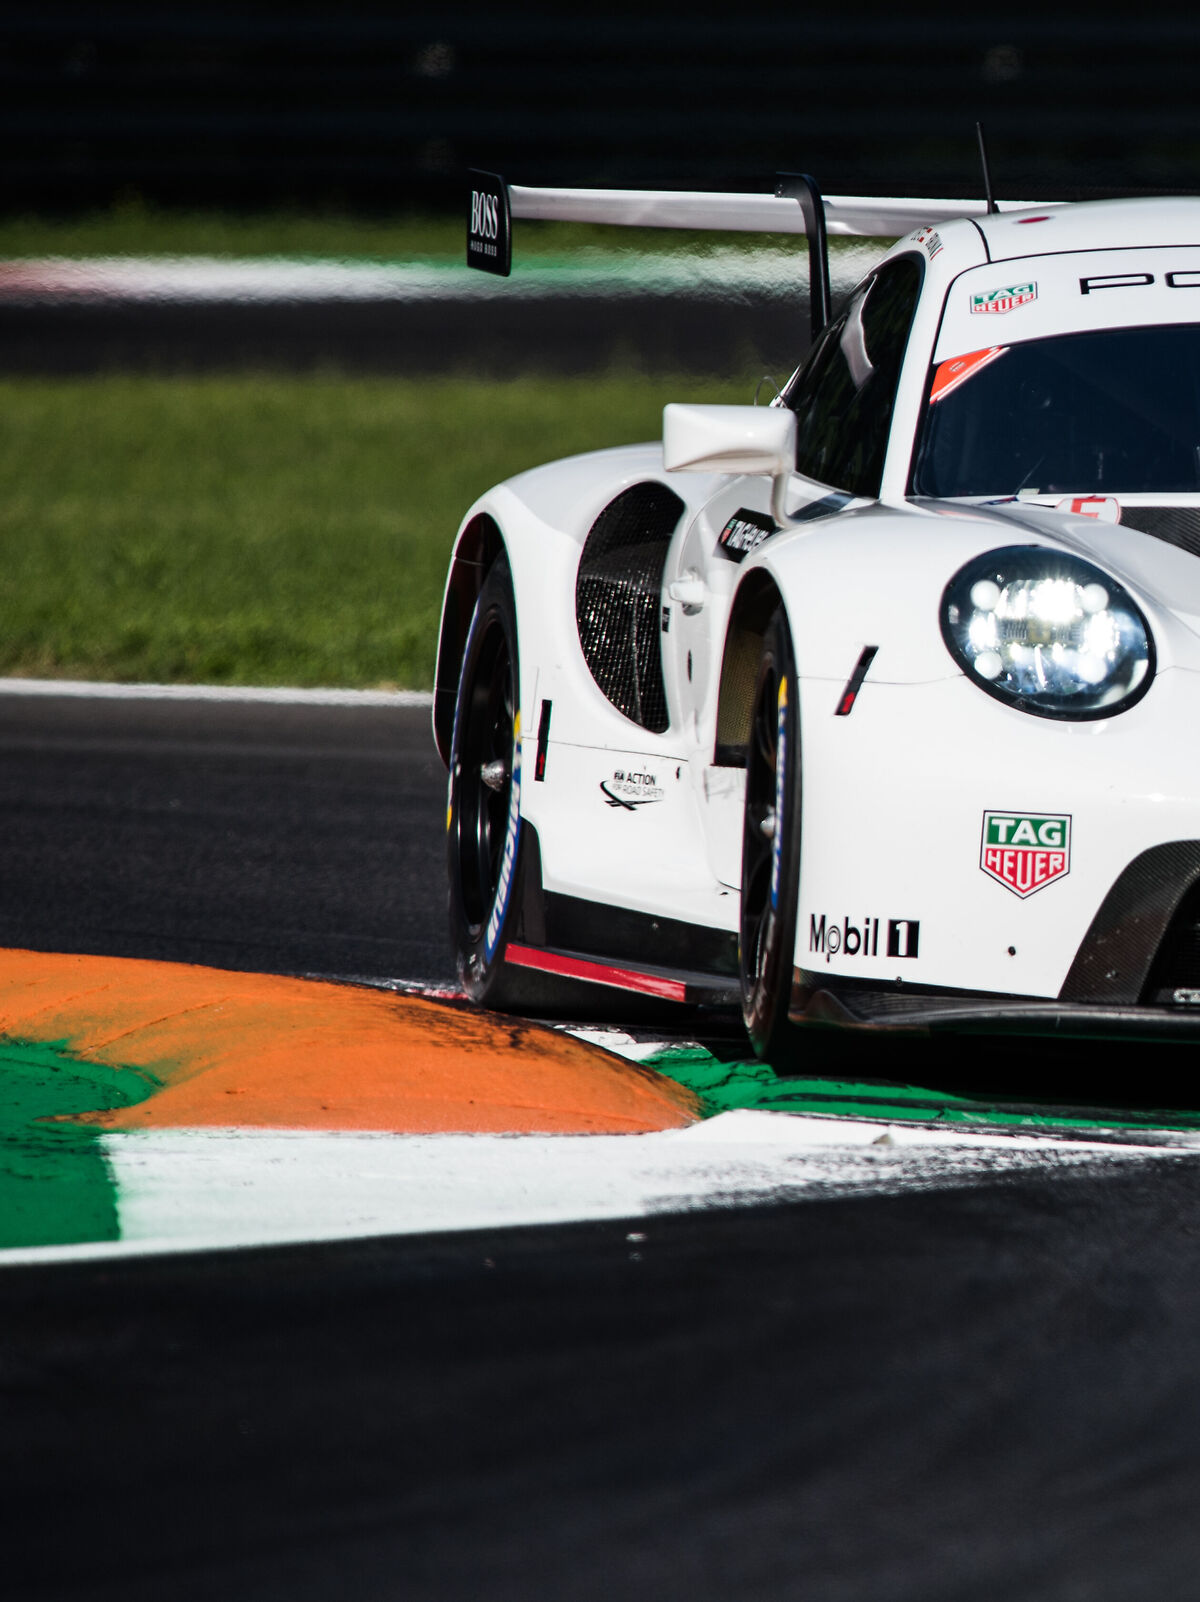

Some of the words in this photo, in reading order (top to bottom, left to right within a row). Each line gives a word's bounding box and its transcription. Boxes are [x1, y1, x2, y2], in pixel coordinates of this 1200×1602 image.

[471, 190, 498, 240] BOSS
[974, 293, 1034, 312] HEUER
[976, 285, 1031, 302] TAG
[626, 772, 657, 785] ACTION
[991, 818, 1062, 846] TAG
[986, 849, 1063, 890] HEUER
[809, 913, 879, 957] Mobil
